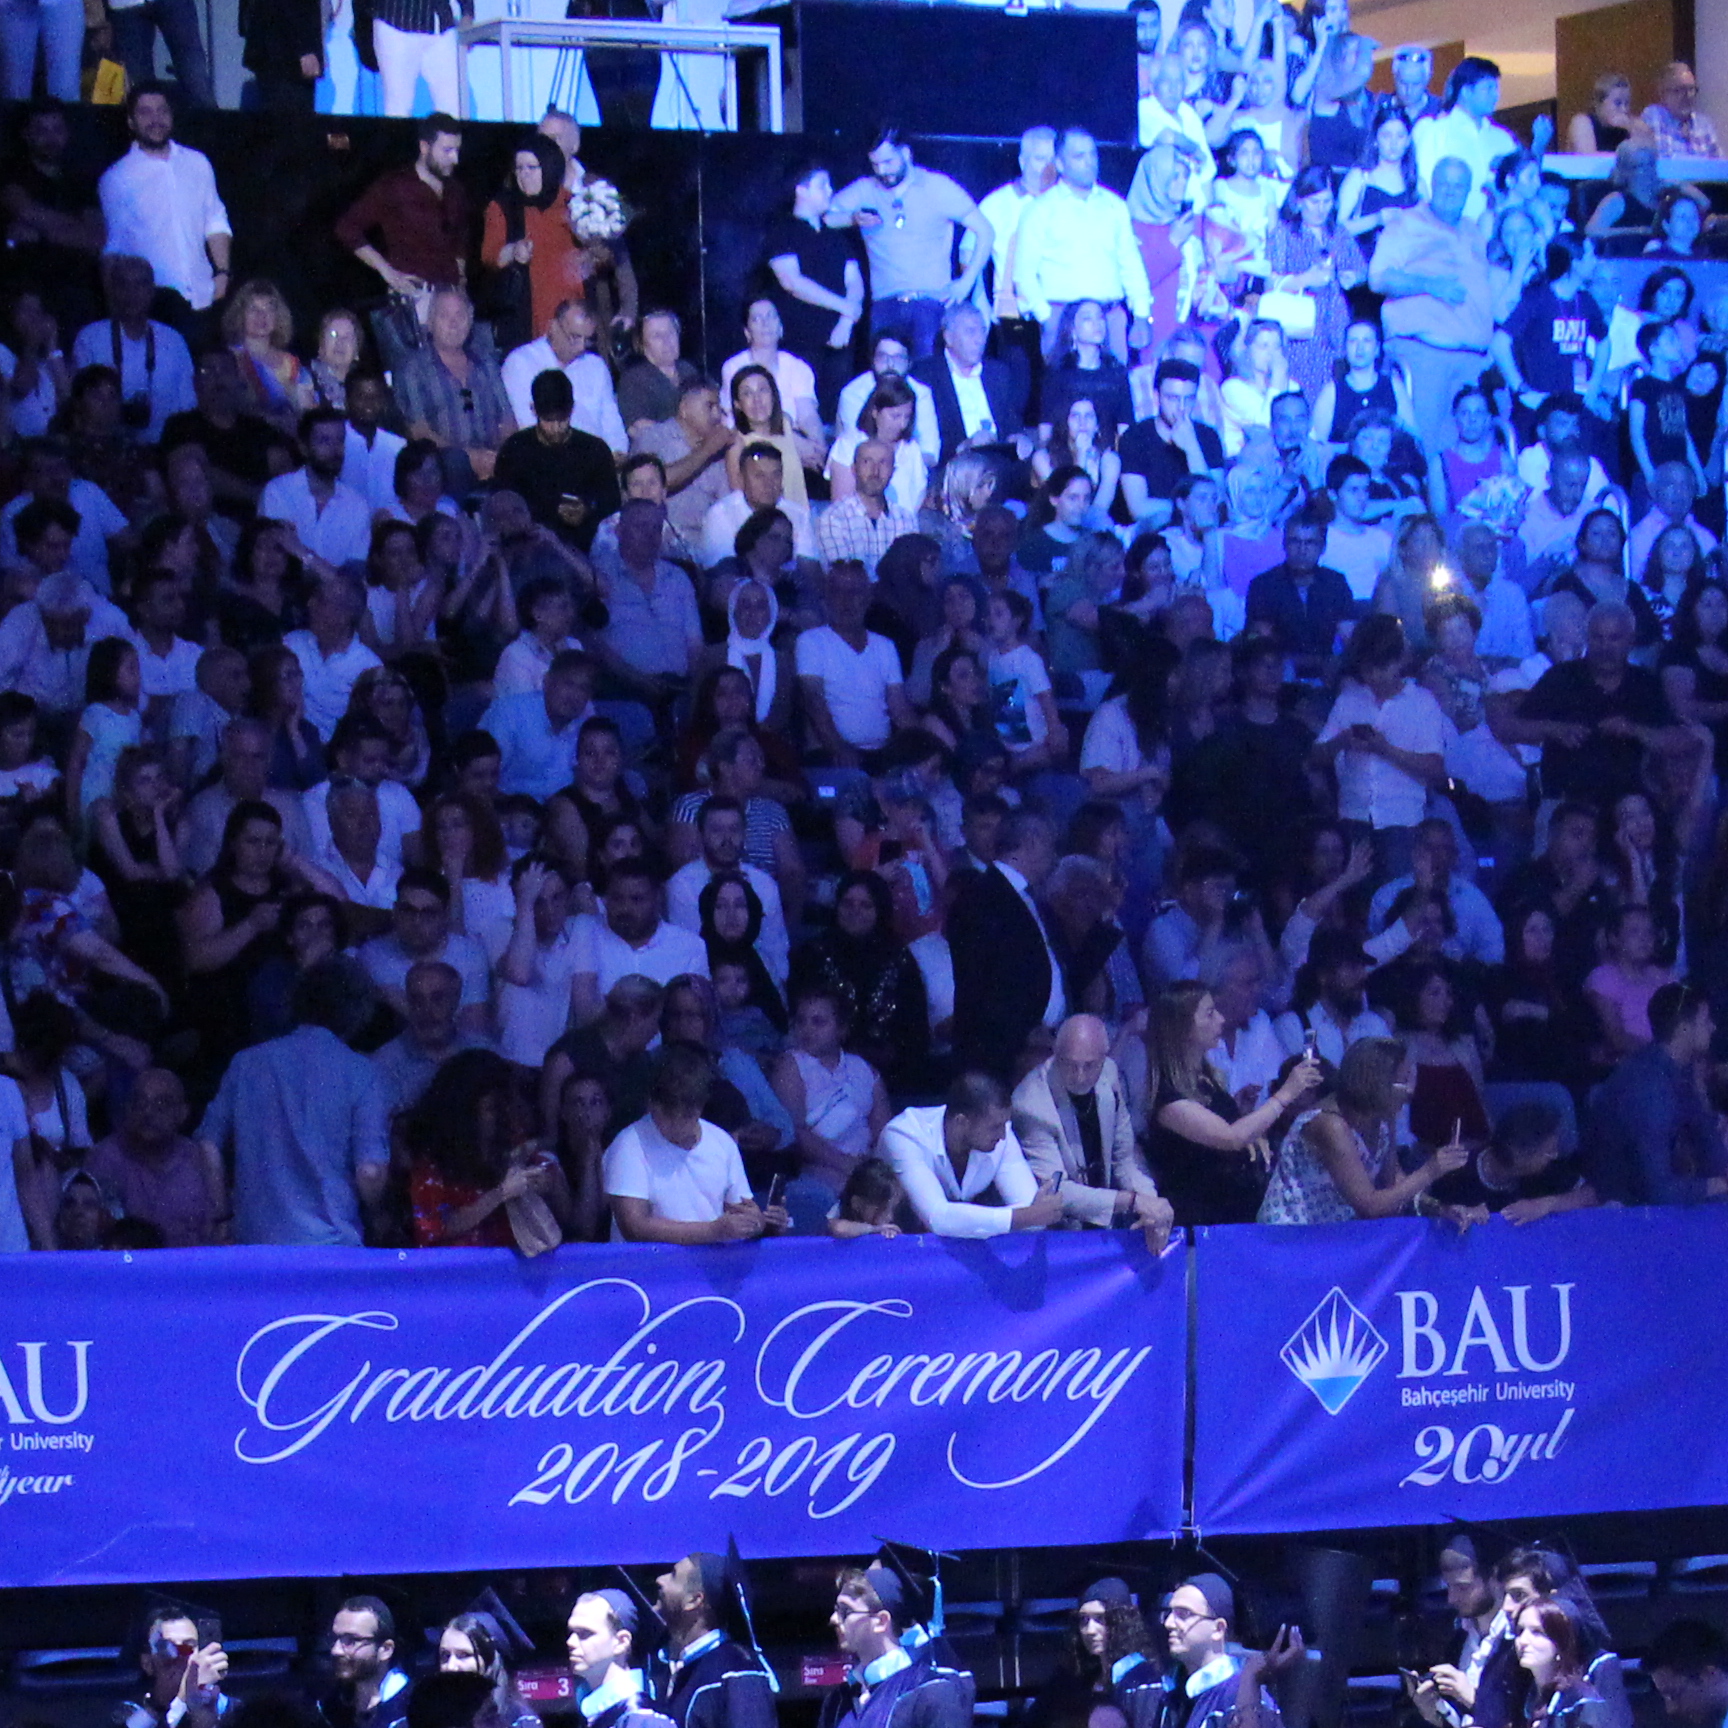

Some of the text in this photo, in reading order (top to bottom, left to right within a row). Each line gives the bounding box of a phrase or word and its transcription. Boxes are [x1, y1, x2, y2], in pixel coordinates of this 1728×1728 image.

[1394, 1282, 1575, 1379] BAU
[235, 1277, 1152, 1490] Graduation Ceremony
[1401, 1378, 1576, 1408] Bahçeşehir University
[10, 1430, 95, 1453] University
[508, 1428, 898, 1519] 2018-2019
[557, 1676, 570, 1697] 3
